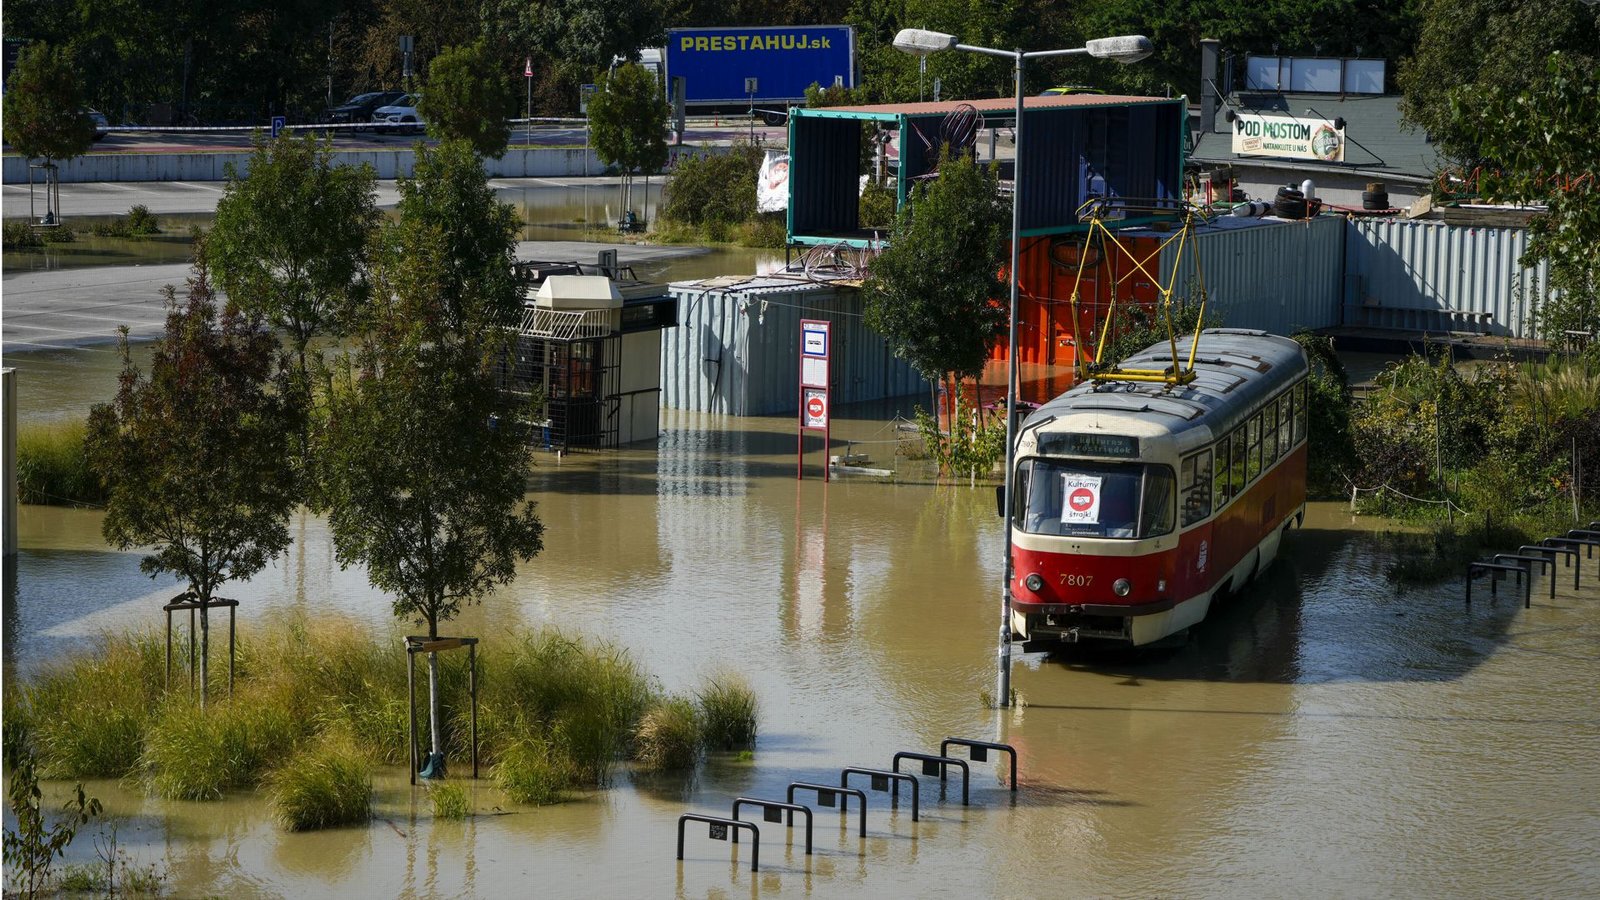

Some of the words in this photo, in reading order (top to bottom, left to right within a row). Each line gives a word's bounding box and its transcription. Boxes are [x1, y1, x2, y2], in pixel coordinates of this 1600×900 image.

[681, 35, 831, 51] PRESTAHUJ.sk
[1237, 121, 1260, 136] POD
[1263, 121, 1311, 141] MOSTOM
[1068, 480, 1099, 489] Kultúrny
[1069, 511, 1092, 519] štrajk!
[1060, 573, 1094, 587] 7807
